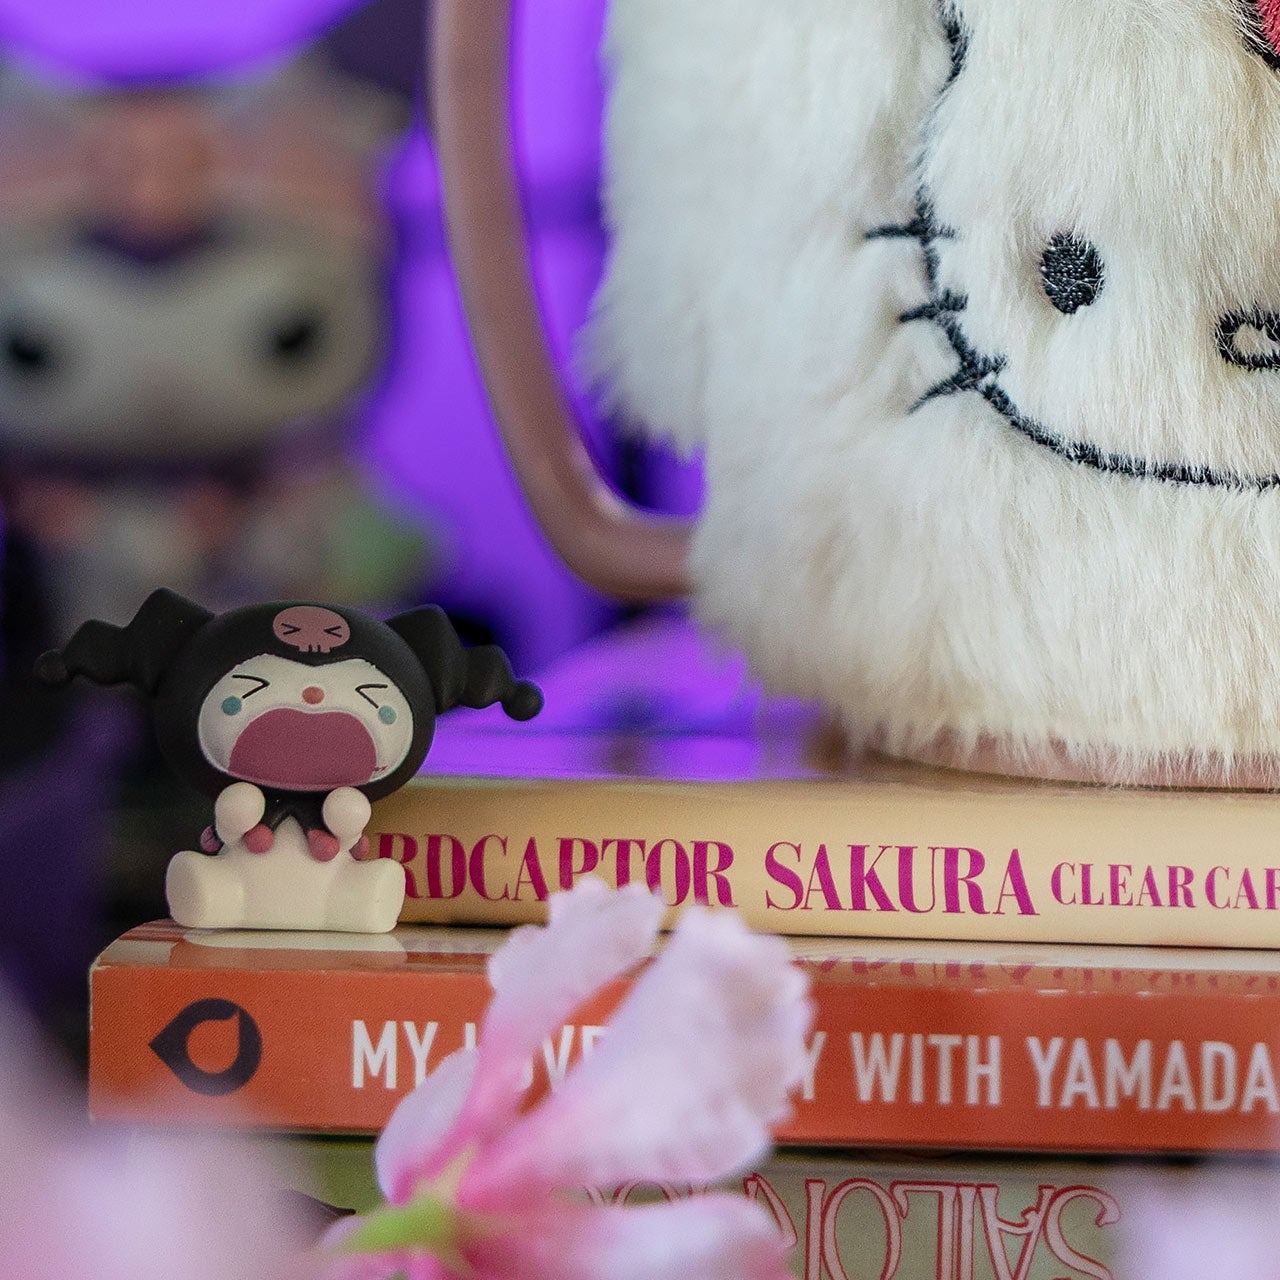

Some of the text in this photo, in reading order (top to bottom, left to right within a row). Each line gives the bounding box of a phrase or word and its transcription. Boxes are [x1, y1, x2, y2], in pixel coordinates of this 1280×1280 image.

[765, 841, 1040, 916] SAKURA
[1051, 861, 1197, 908] CLEAR
[352, 1020, 439, 1089] MY
[850, 1032, 1001, 1106] WITH
